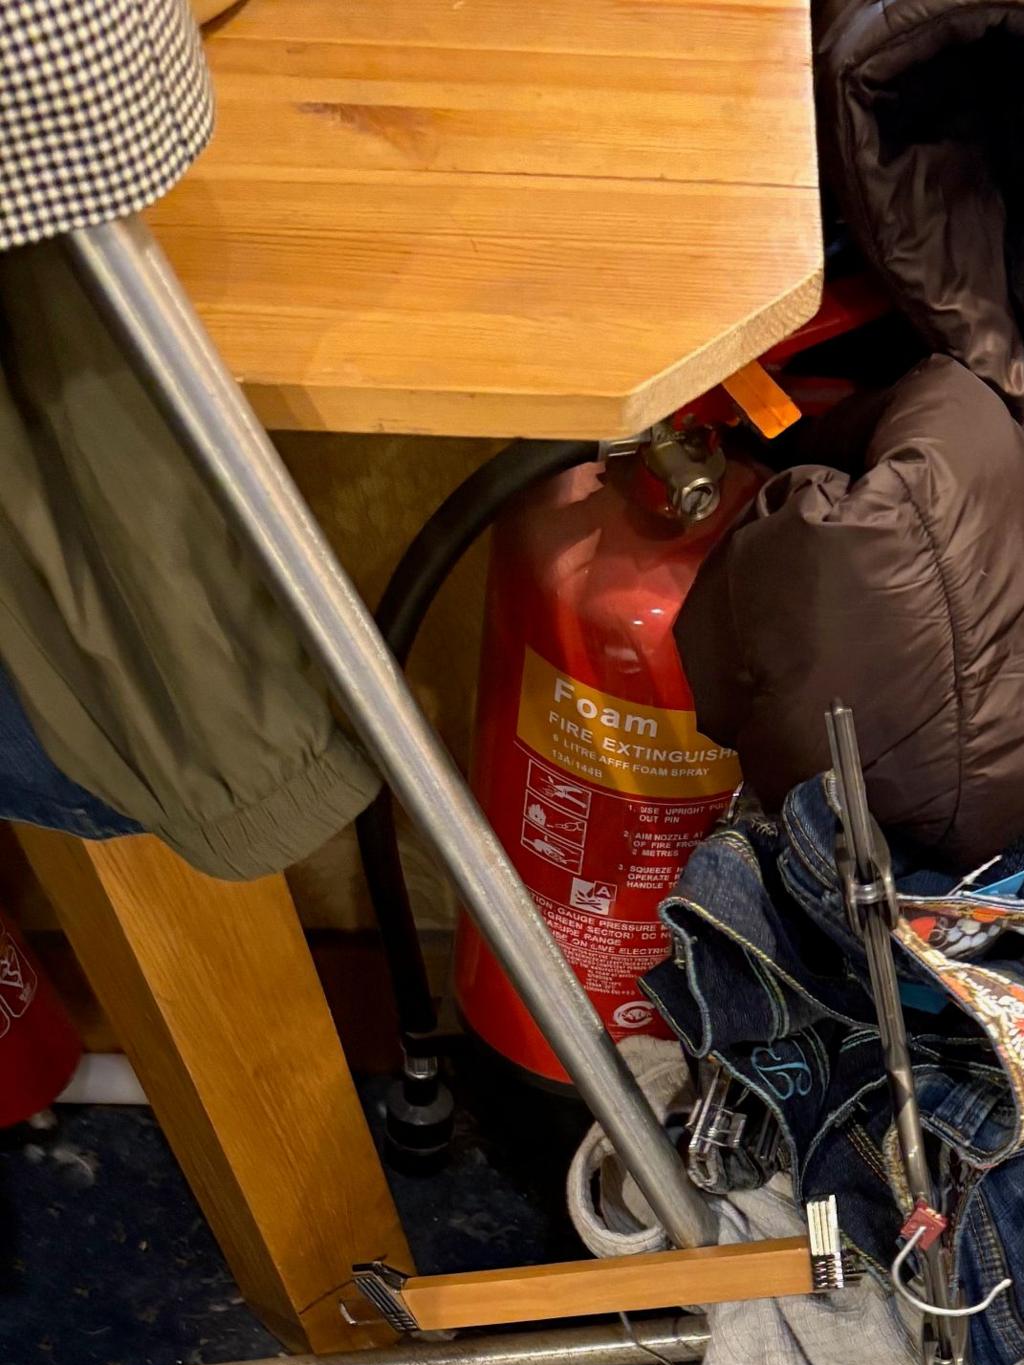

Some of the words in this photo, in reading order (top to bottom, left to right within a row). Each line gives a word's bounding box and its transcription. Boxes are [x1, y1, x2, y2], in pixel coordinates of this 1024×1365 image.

[554, 677, 657, 737] Foam
[548, 710, 593, 743] FIRE
[563, 739, 596, 759] LITRE
[599, 755, 630, 770] AFFF
[632, 763, 668, 776] FOAM
[671, 766, 709, 777] SPRAY
[665, 805, 704, 815] UPRIGHT
[639, 814, 657, 822] OUT
[635, 832, 652, 840] AIM
[654, 832, 689, 841] NOZZLE
[641, 848, 678, 857] METRES
[629, 865, 672, 874] SQUEEZE
[627, 873, 669, 881] OPERATE
[626, 880, 663, 889] HANDLE
[556, 906, 596, 926] GAUGE
[599, 921, 656, 931] PRESSURE
[572, 939, 587, 947] ON
[583, 933, 621, 945] RANGE
